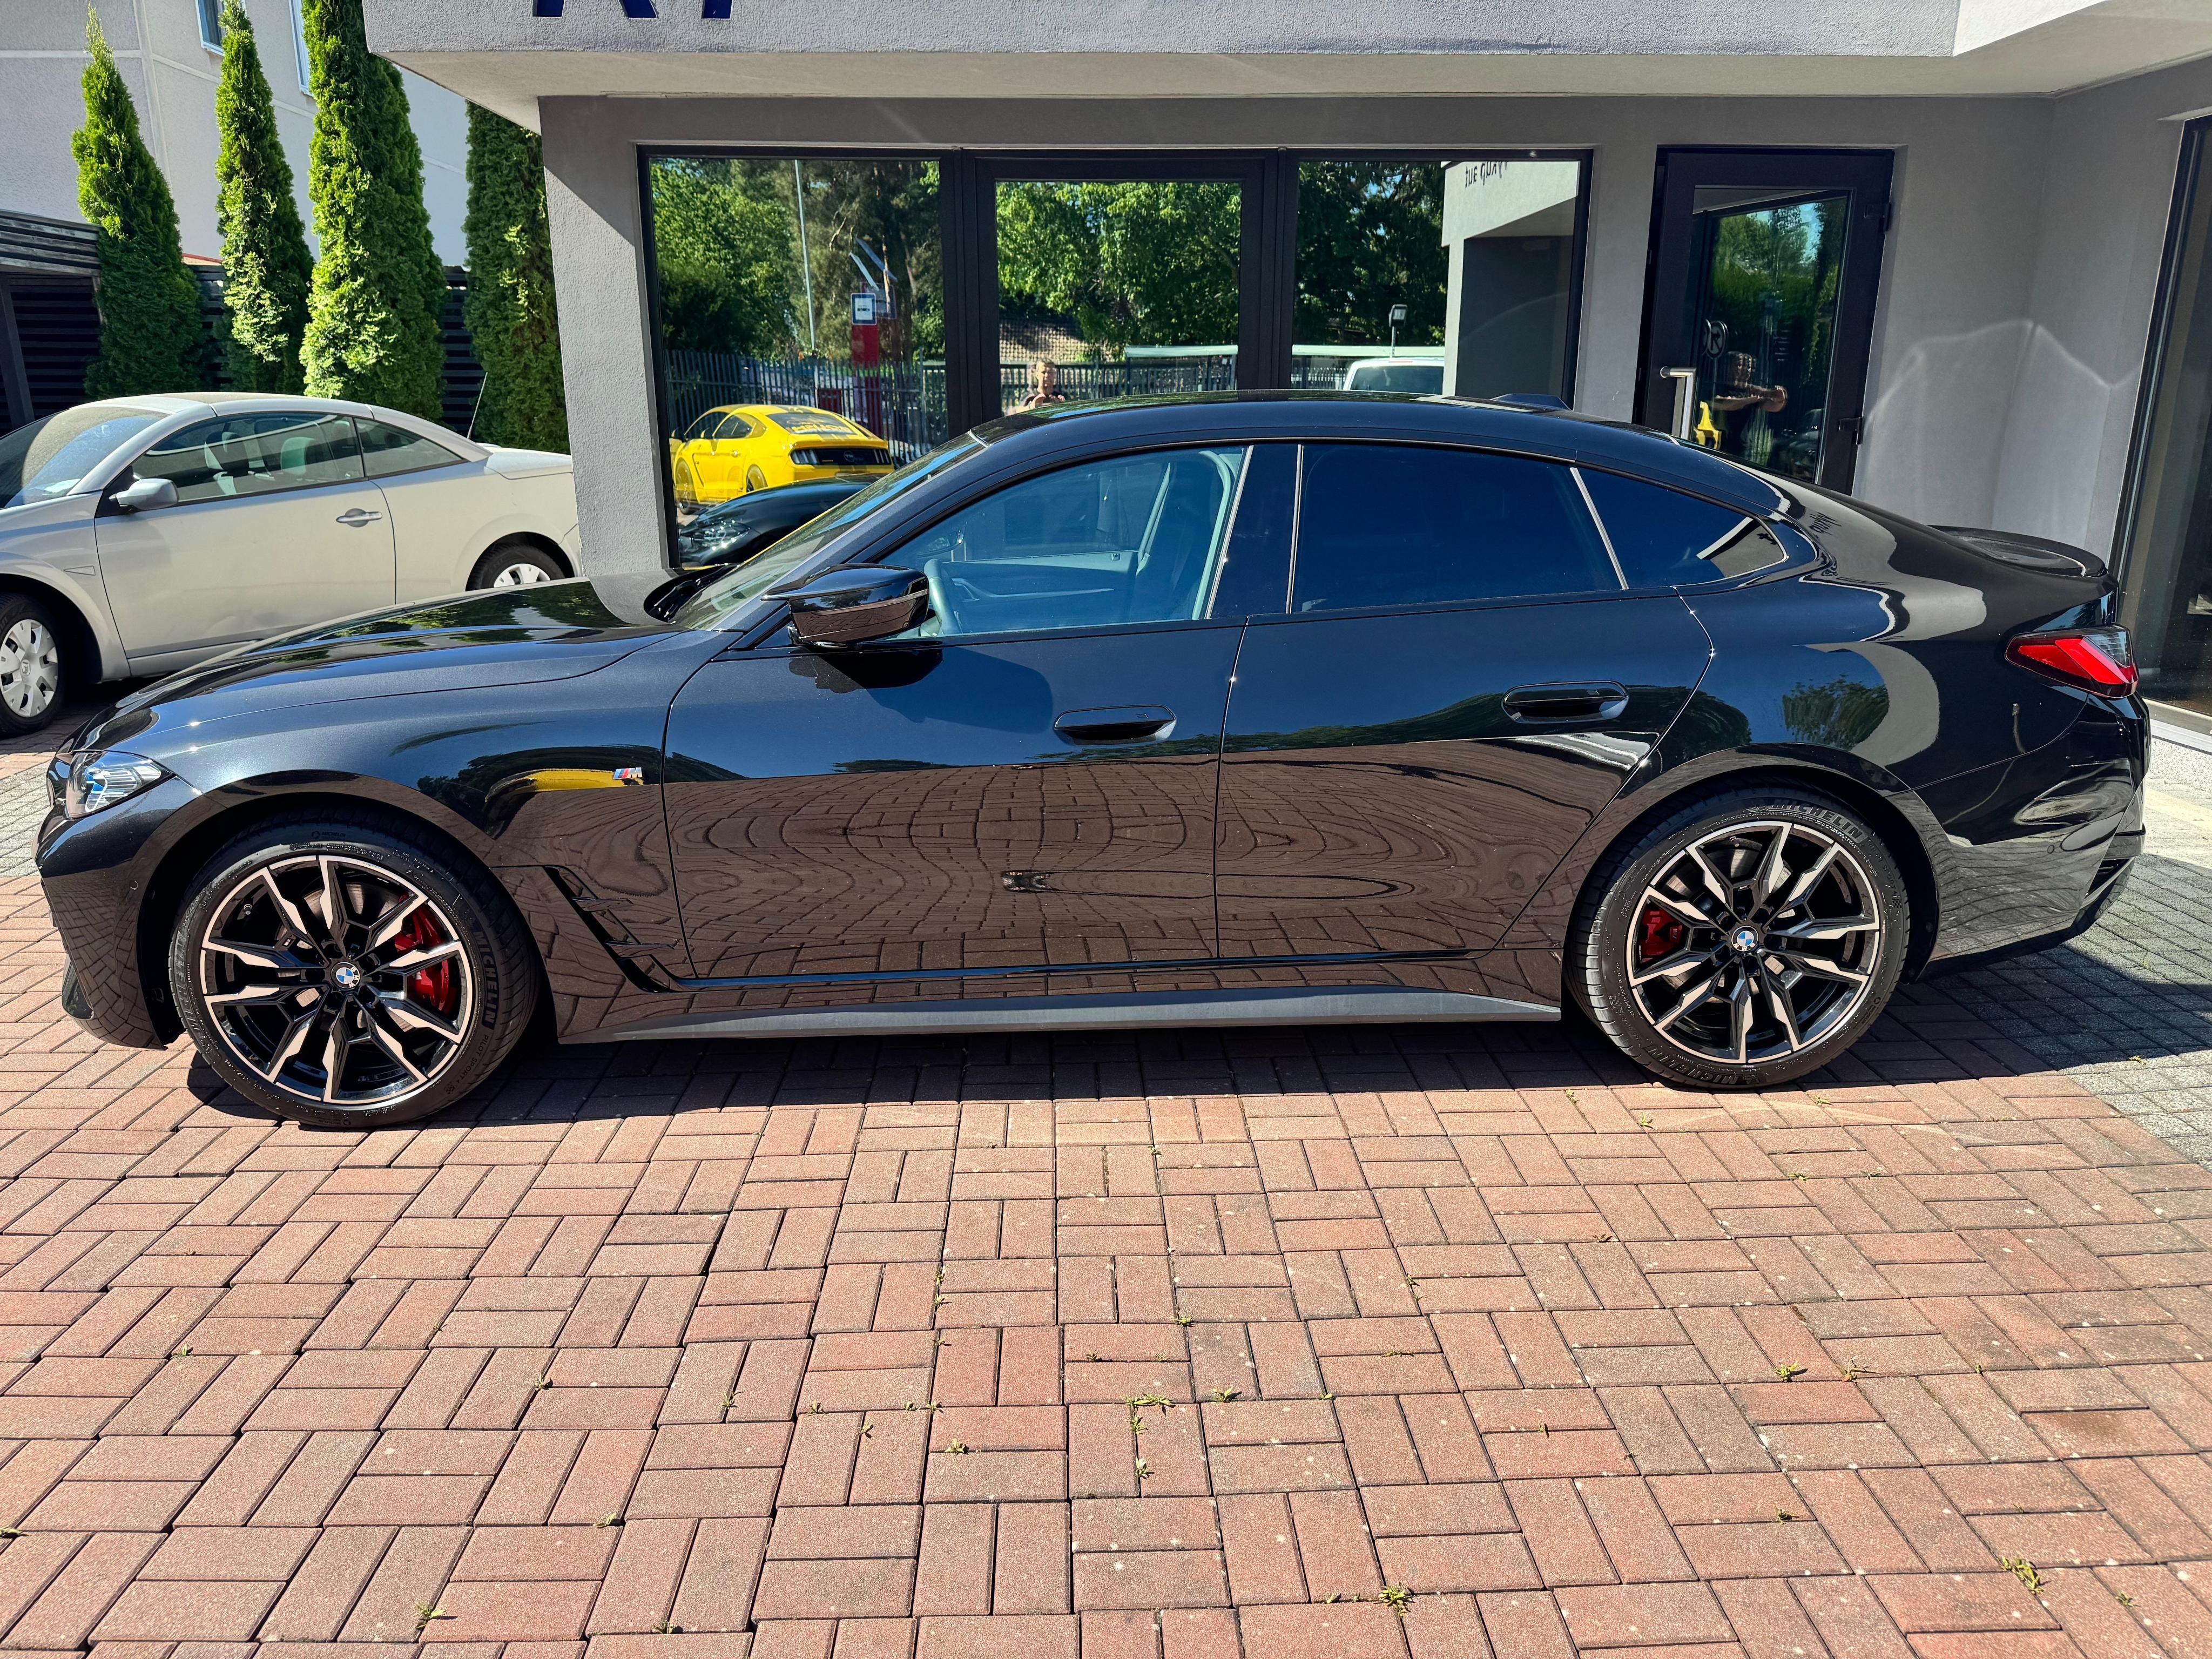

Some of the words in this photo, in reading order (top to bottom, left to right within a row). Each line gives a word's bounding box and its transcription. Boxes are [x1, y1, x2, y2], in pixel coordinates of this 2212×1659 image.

[1771, 801, 1863, 839] MICHELIN
[473, 932, 497, 1023] MICHELIN
[475, 1034, 489, 1055] PILOT
[459, 1056, 477, 1080] SPORT
[1648, 1048, 1739, 1084] MICHELIN
